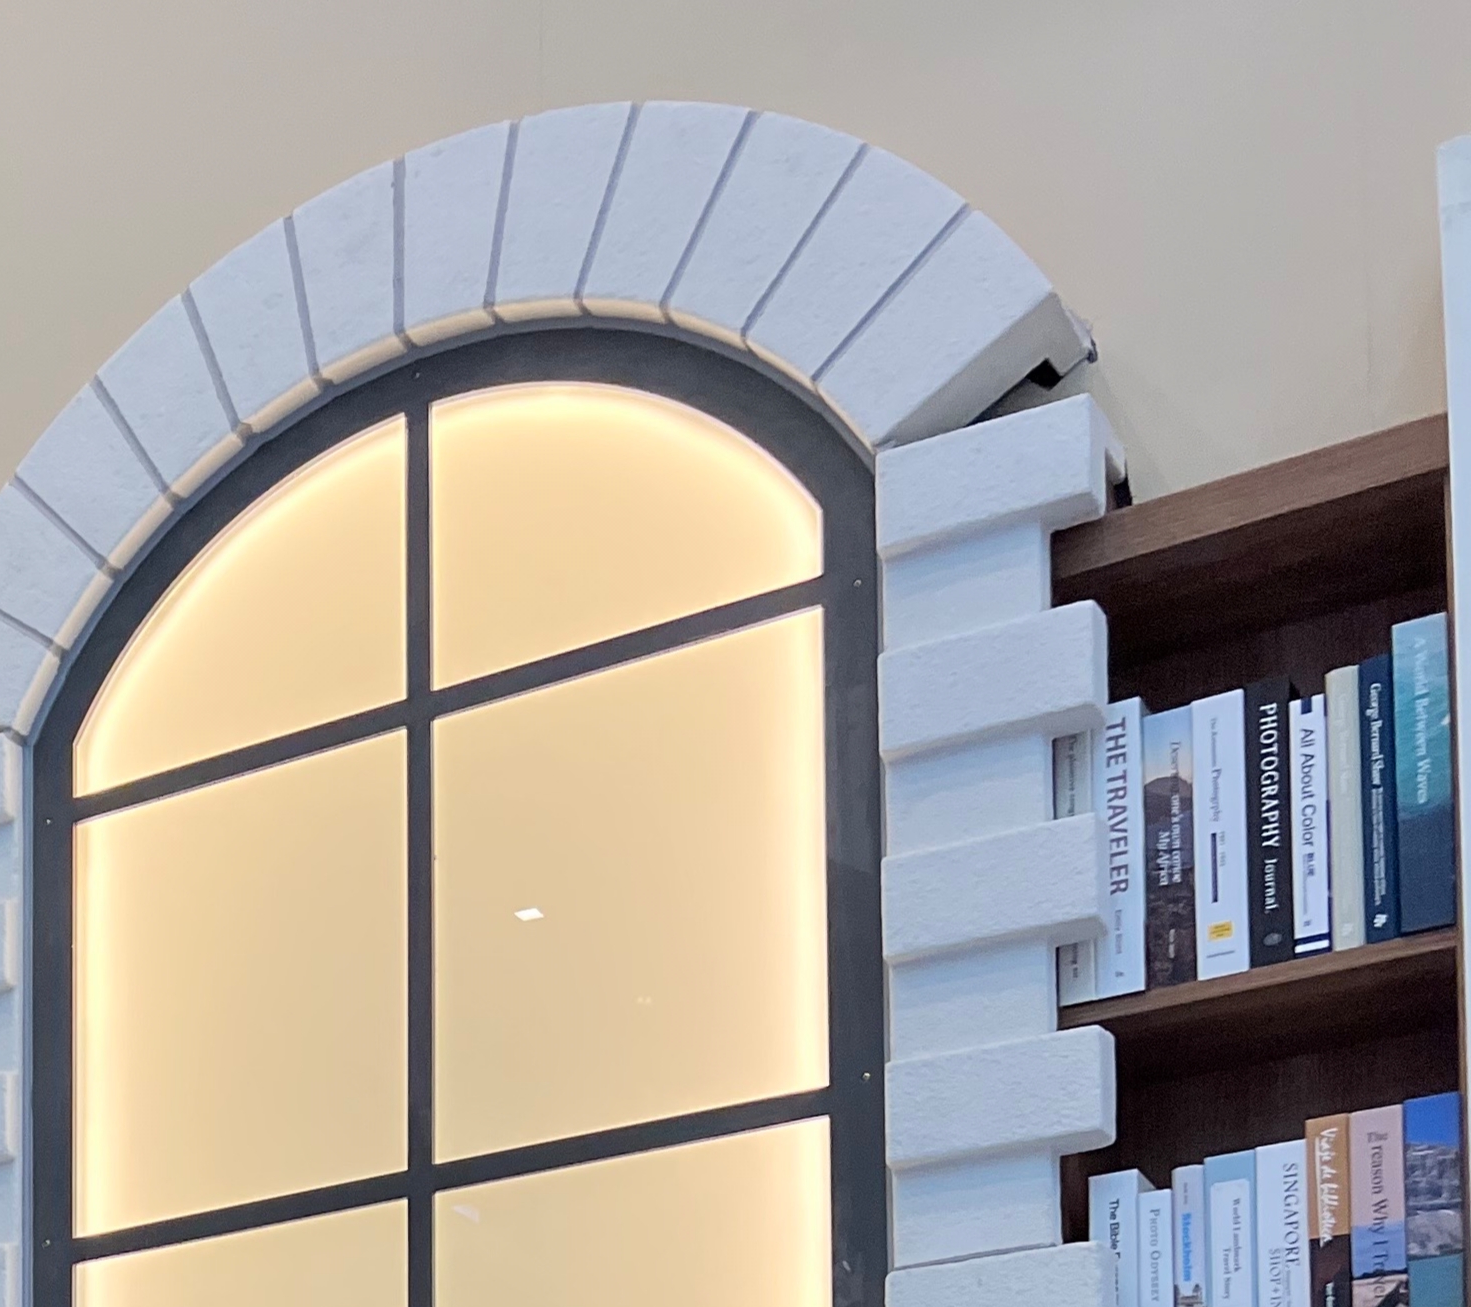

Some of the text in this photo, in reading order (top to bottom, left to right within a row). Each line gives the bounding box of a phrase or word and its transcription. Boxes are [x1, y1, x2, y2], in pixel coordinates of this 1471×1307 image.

[1366, 683, 1381, 718] George
[1369, 721, 1382, 758] Bernard
[1415, 700, 1428, 757] Between
[1259, 703, 1279, 848] PHOTOGRAPHY
[1300, 728, 1316, 847] All About Color
[1370, 761, 1382, 786] Shaw
[1417, 760, 1430, 804] Waves
[1107, 716, 1129, 896] THE TRAVELER
[1371, 1145, 1386, 1194] reason
[1108, 1198, 1120, 1219] The
[1282, 1162, 1301, 1268] SINGAPORE
[1370, 1200, 1389, 1235] Why
[1109, 1222, 1121, 1250] Bible
[1181, 1213, 1192, 1282] Stockholm
[1231, 1199, 1242, 1273] World Landmark
[1220, 1248, 1231, 1301] Travel Story
